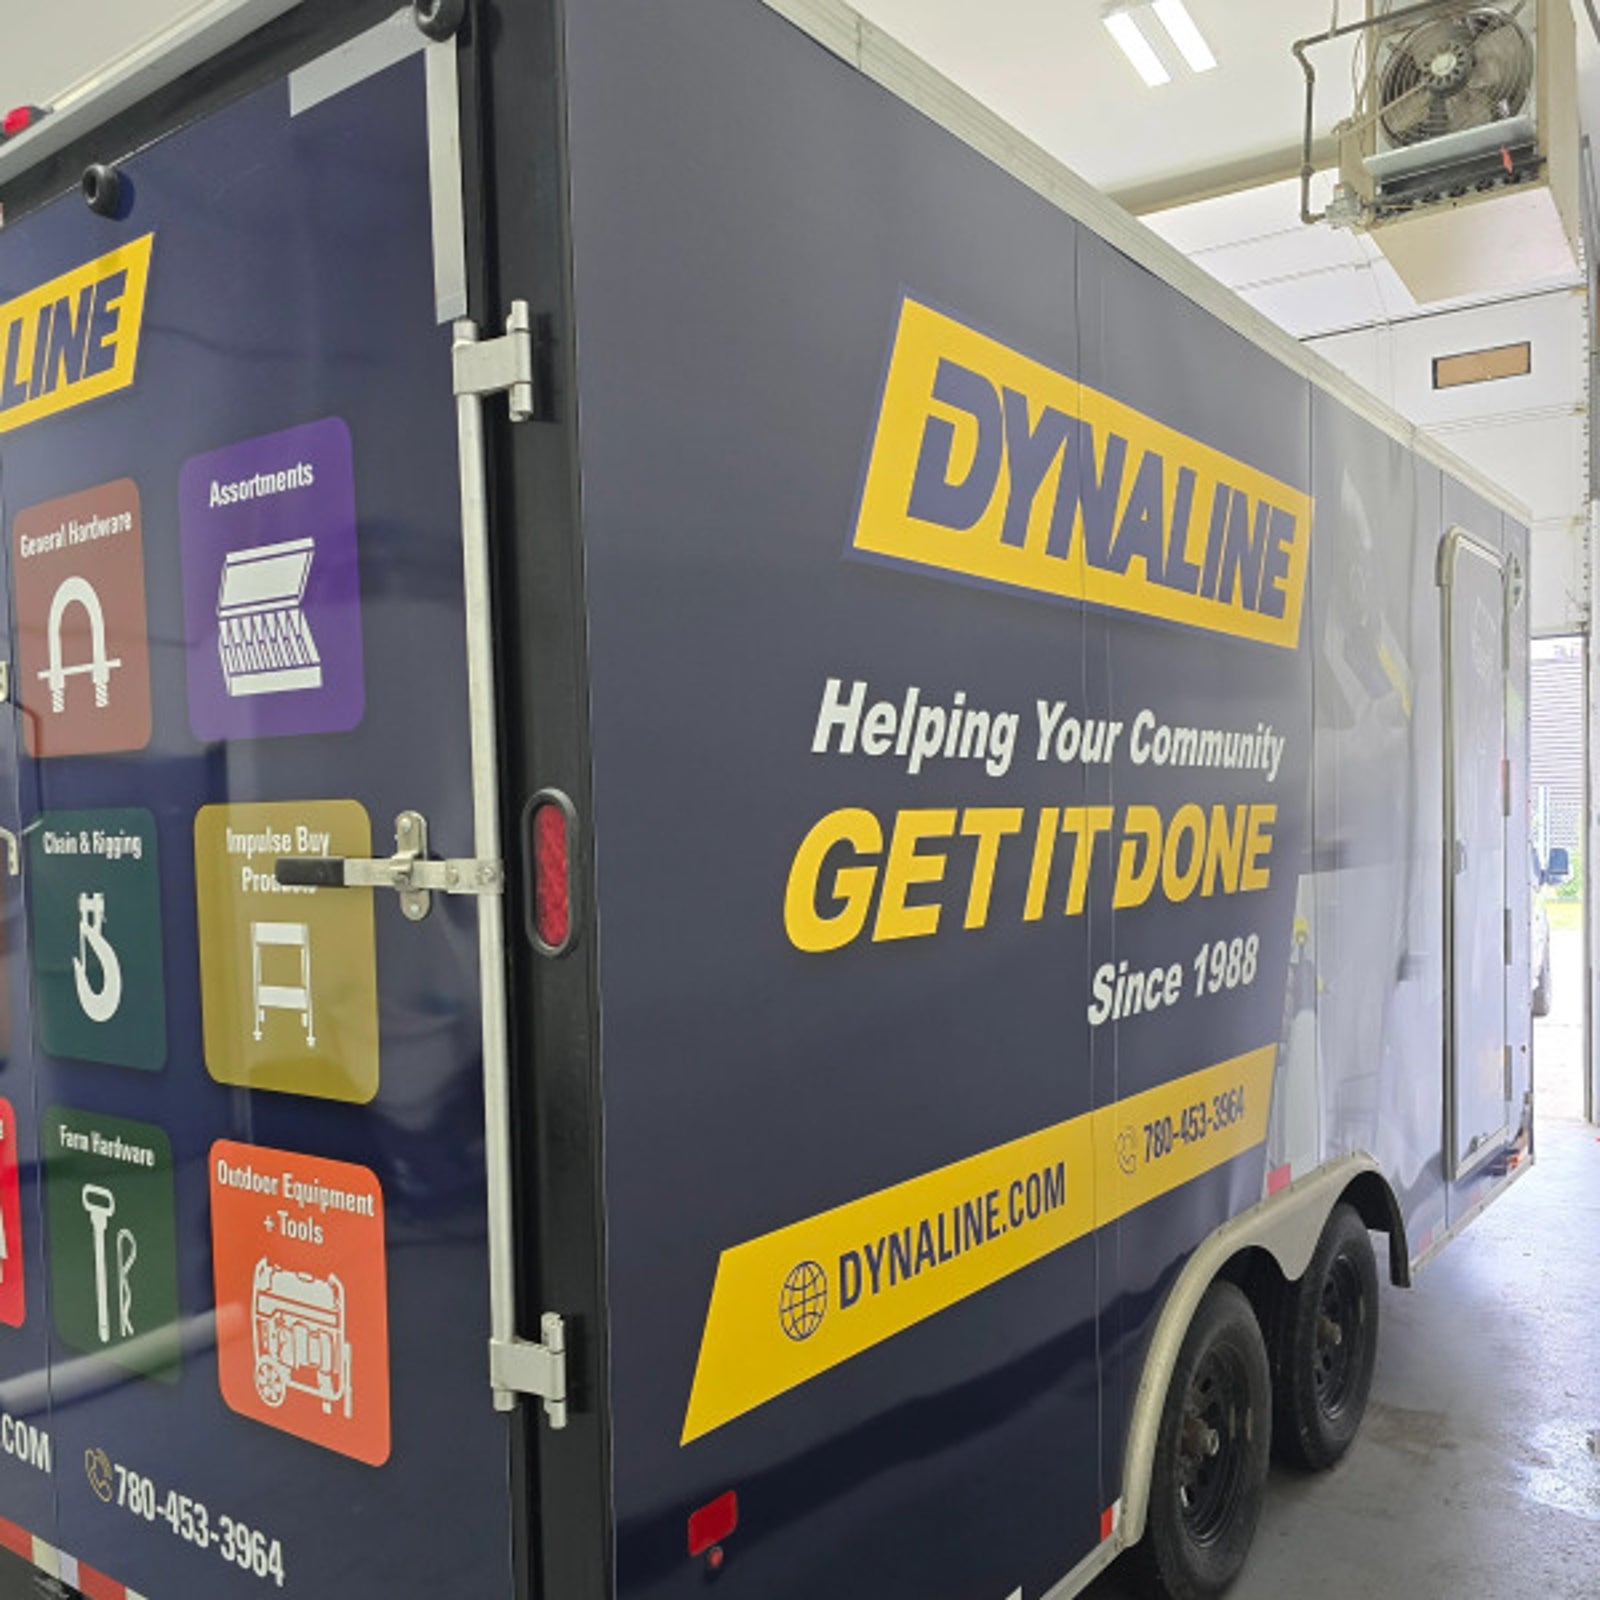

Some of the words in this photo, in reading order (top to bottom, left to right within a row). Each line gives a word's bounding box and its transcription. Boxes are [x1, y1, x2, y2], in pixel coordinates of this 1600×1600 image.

[0, 270, 127, 412] LINE
[209, 462, 314, 508] Assortments
[907, 357, 1297, 620] DYNALINE
[20, 523, 67, 558] General
[69, 511, 132, 544] Hardware
[811, 678, 1019, 776] Helping
[1036, 700, 1122, 765] Your
[1130, 709, 1285, 783] Community
[42, 831, 78, 854] Chain
[80, 831, 91, 854] &
[93, 830, 142, 859] Rigging
[226, 826, 291, 859] Impulse
[296, 825, 329, 857] Buy
[783, 807, 1023, 953] GET
[1023, 806, 1112, 922] IT
[1112, 803, 1277, 910] DONE
[1087, 957, 1181, 1026] Since
[1193, 934, 1260, 999] 1988
[58, 1124, 89, 1151] Farm
[91, 1131, 155, 1166] Hardware
[1143, 1084, 1245, 1163] 780-453-3964
[217, 1159, 280, 1198] Outdoor
[281, 1173, 375, 1217] Equipment
[263, 1215, 274, 1232] +
[277, 1210, 324, 1245] Tools
[838, 1161, 1066, 1310] DYNALINE.COM
[114, 1463, 284, 1588] 780-453-3964
